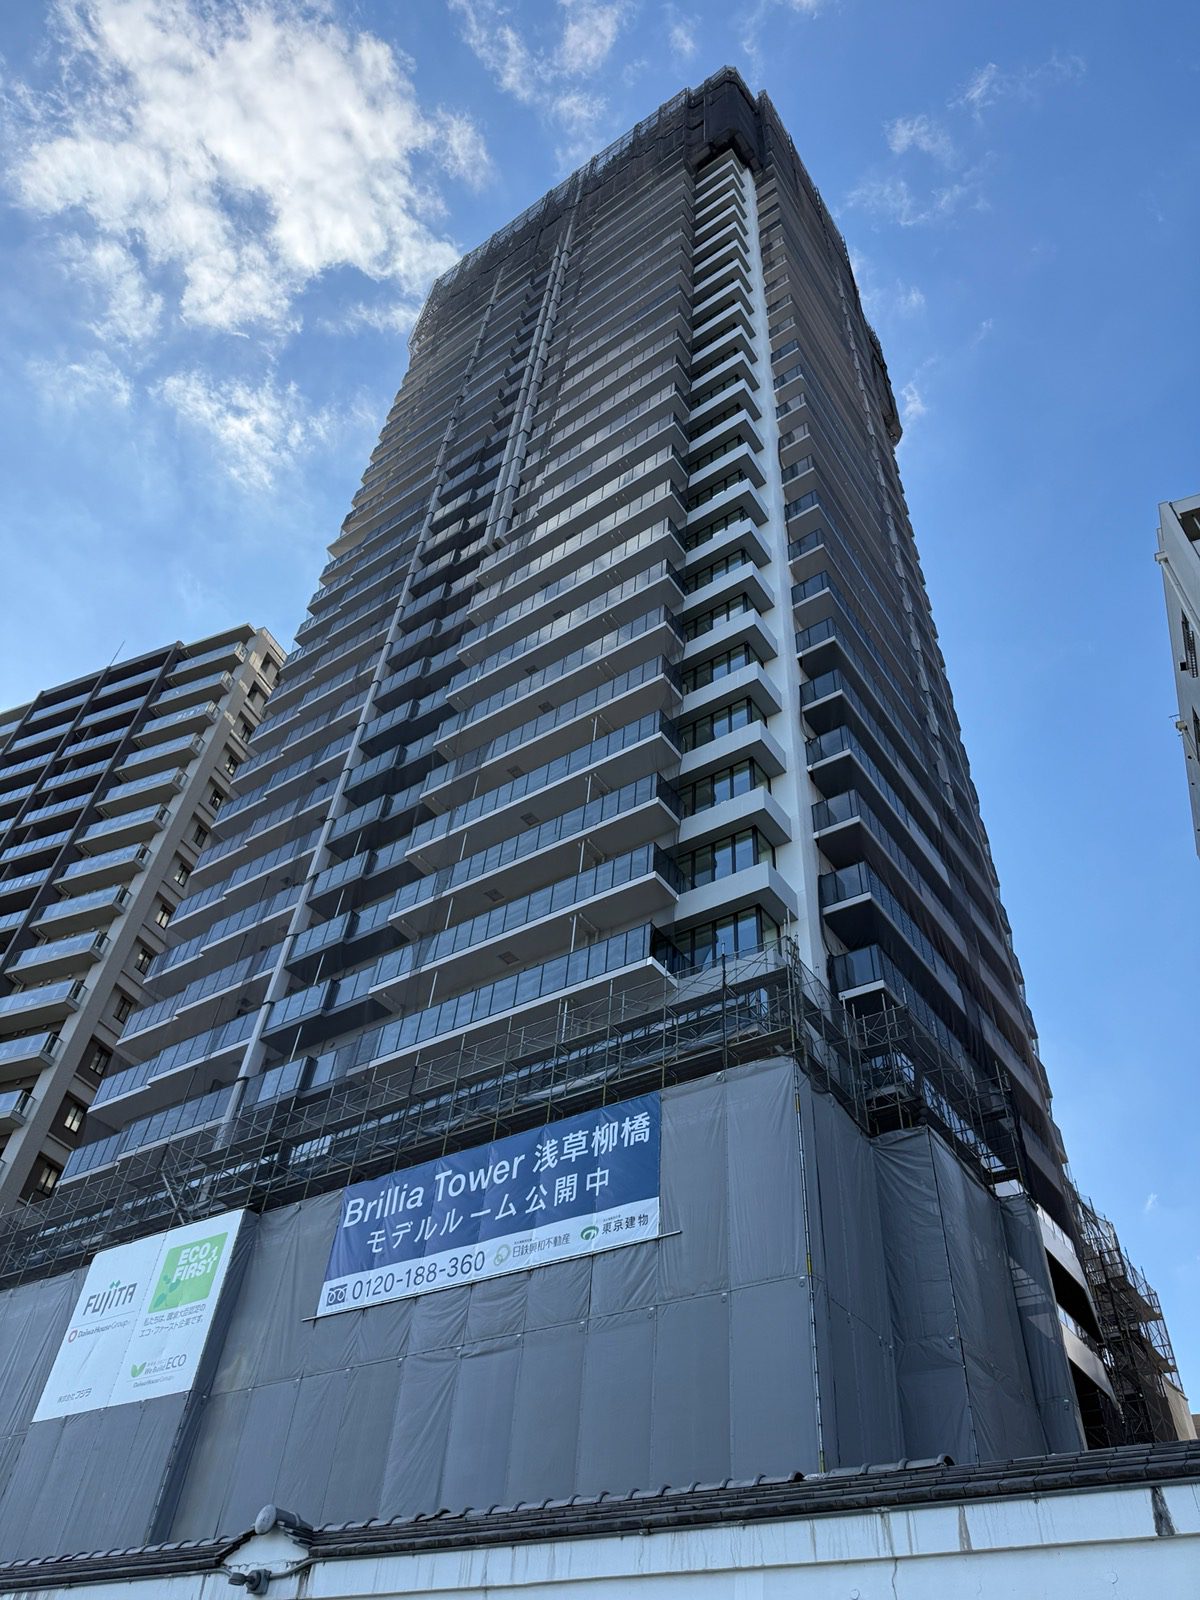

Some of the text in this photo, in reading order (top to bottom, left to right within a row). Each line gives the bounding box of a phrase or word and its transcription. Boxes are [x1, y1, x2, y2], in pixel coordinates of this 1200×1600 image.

[343, 1111, 650, 1228] Brillia Tower 浅草柳橋
[366, 1166, 610, 1254] モデルルーム公開中
[602, 1213, 649, 1235] 東京建物
[178, 1242, 211, 1265] ECO
[512, 1232, 570, 1258] 日鉄興和不動産
[172, 1257, 217, 1283] FIRST
[352, 1251, 485, 1300] 0120-188-360
[83, 1281, 138, 1316] FUJITA
[166, 1353, 187, 1370] ECO
